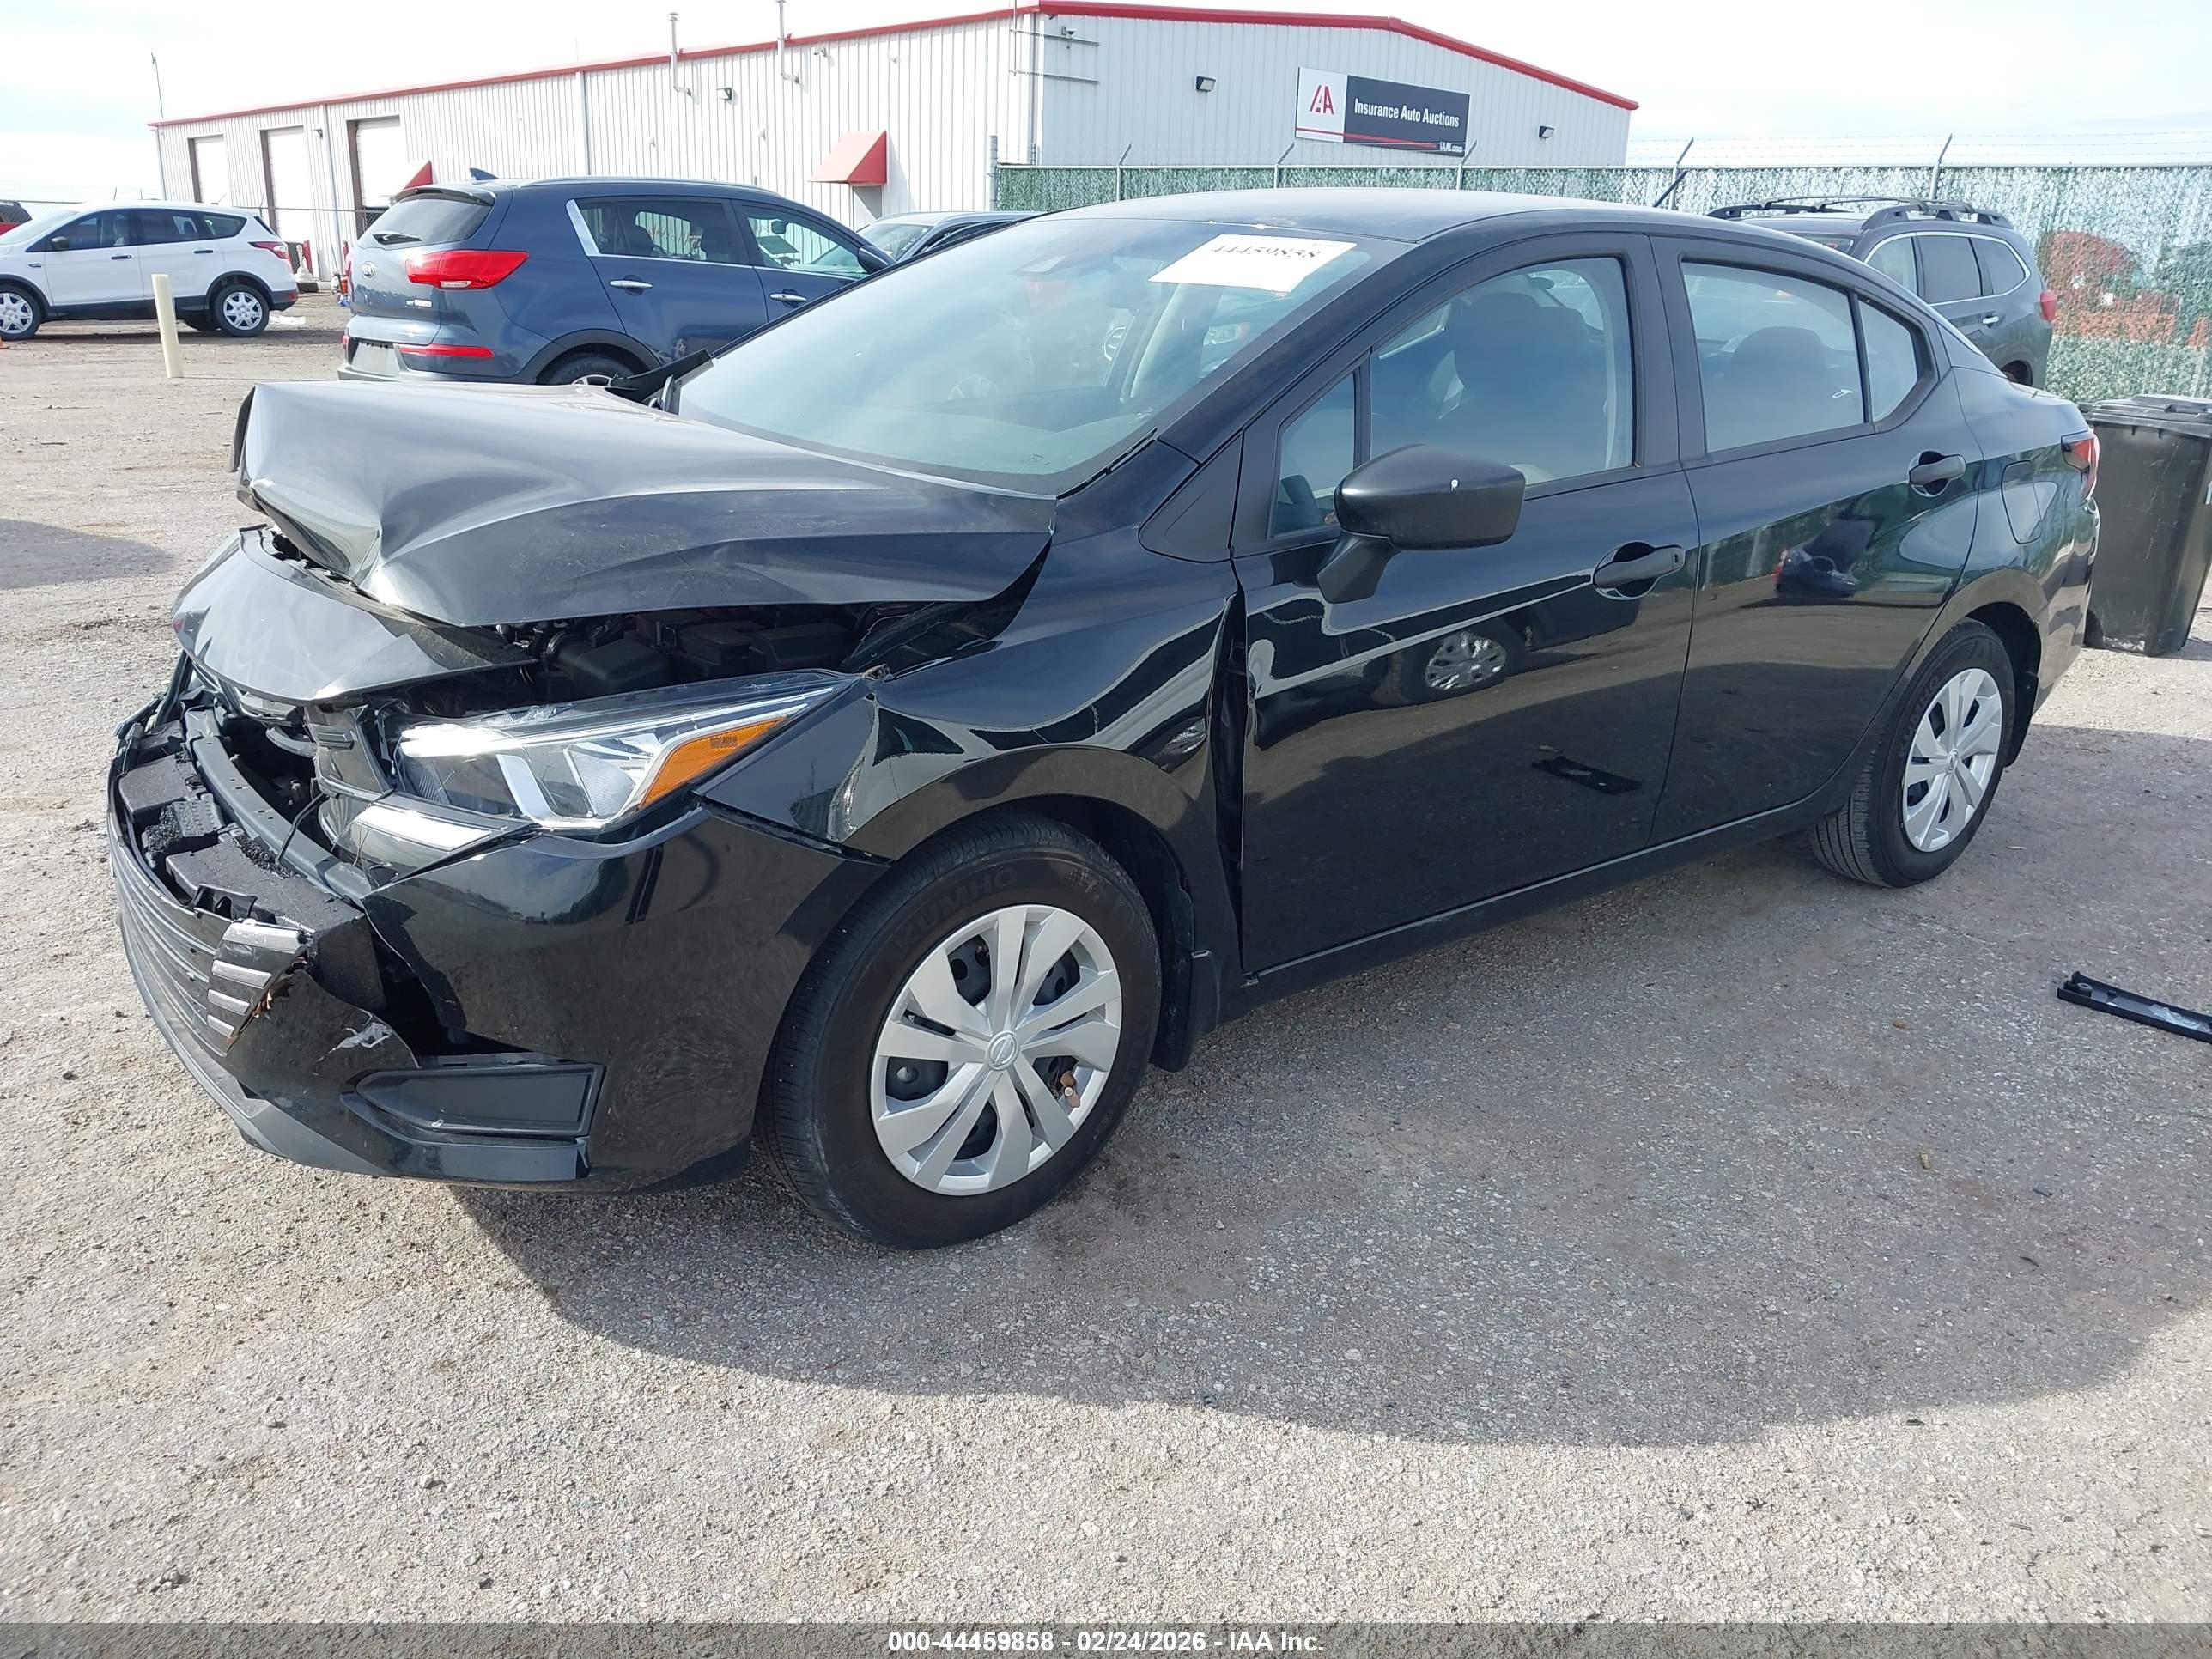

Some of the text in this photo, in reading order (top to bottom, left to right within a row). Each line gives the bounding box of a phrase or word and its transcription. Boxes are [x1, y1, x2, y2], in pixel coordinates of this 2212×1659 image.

[1354, 97, 1460, 128] Insurance Auto Auctions
